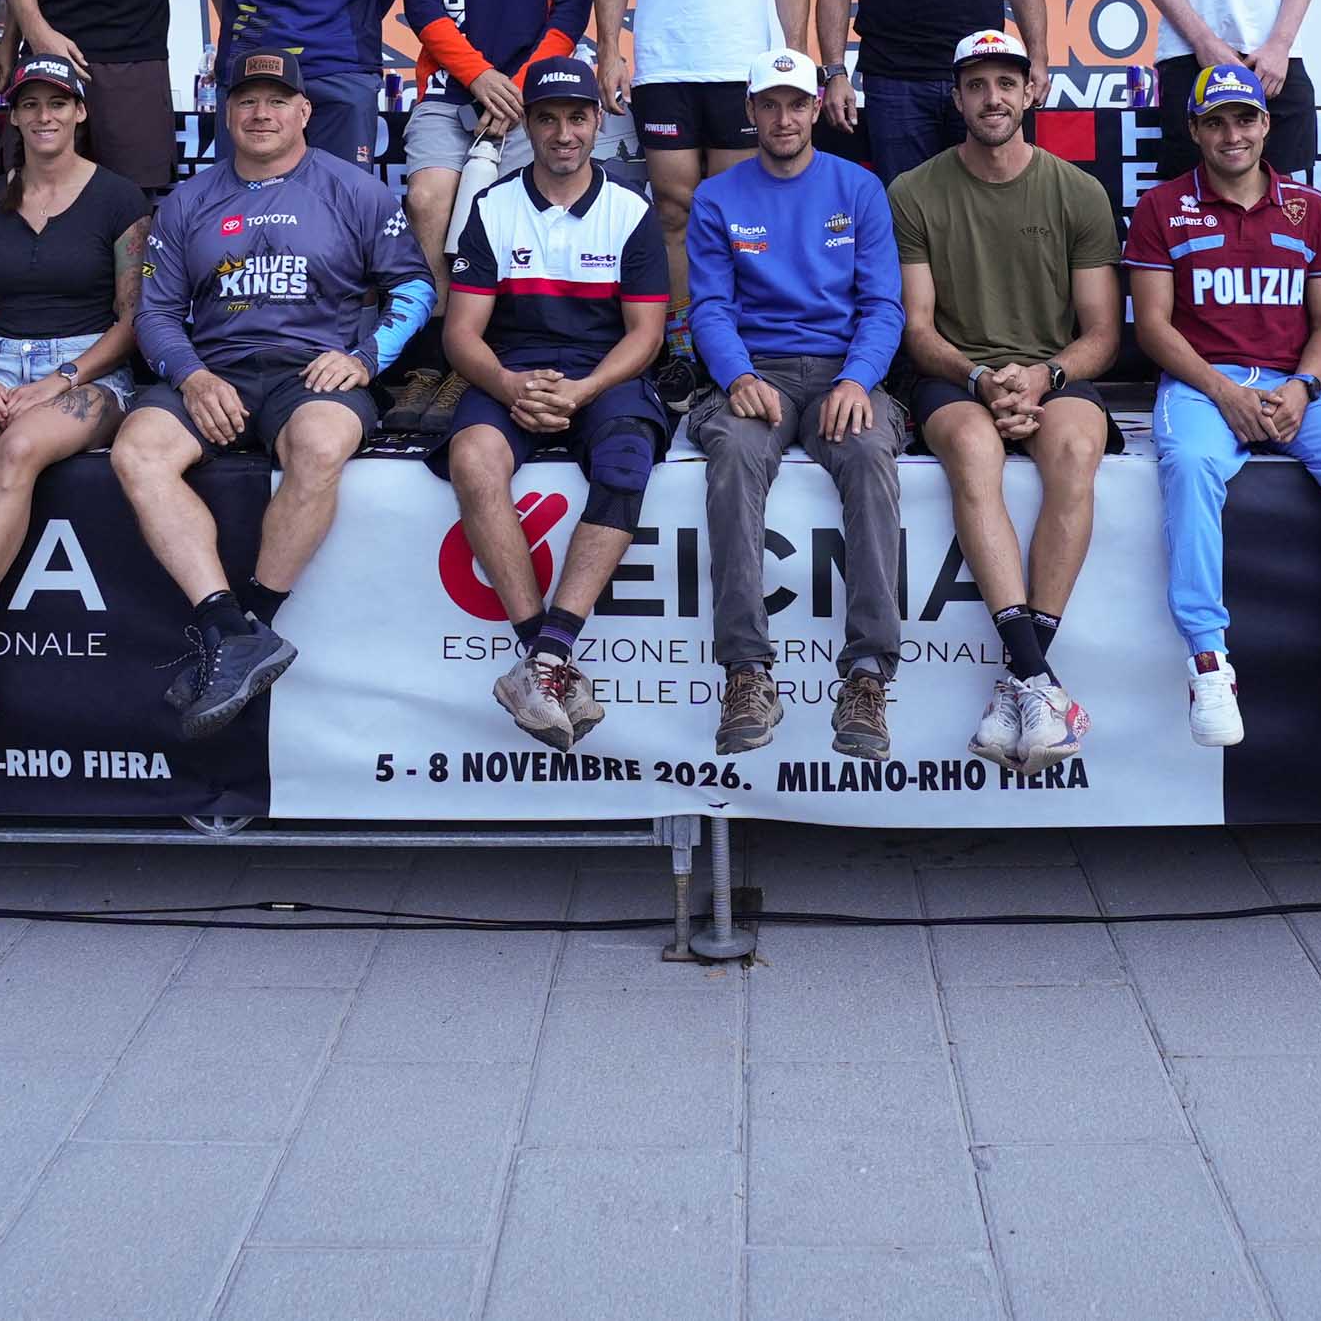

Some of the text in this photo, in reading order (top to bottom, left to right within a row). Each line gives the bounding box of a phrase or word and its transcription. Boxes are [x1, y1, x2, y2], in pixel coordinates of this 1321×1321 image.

[537, 71, 582, 86] Mitas
[246, 214, 298, 227] TOYOTA
[1169, 216, 1203, 228] Allianz
[245, 255, 308, 274] SILVER
[219, 270, 308, 297] KINGS
[1193, 267, 1305, 306] POLIZIA
[84, 751, 172, 781] FIERA
[375, 754, 394, 782] 5
[428, 754, 449, 783] 8
[461, 751, 642, 784] NOVEMBRE
[653, 761, 753, 790] 2026.
[776, 759, 986, 792] MILANO-RHO
